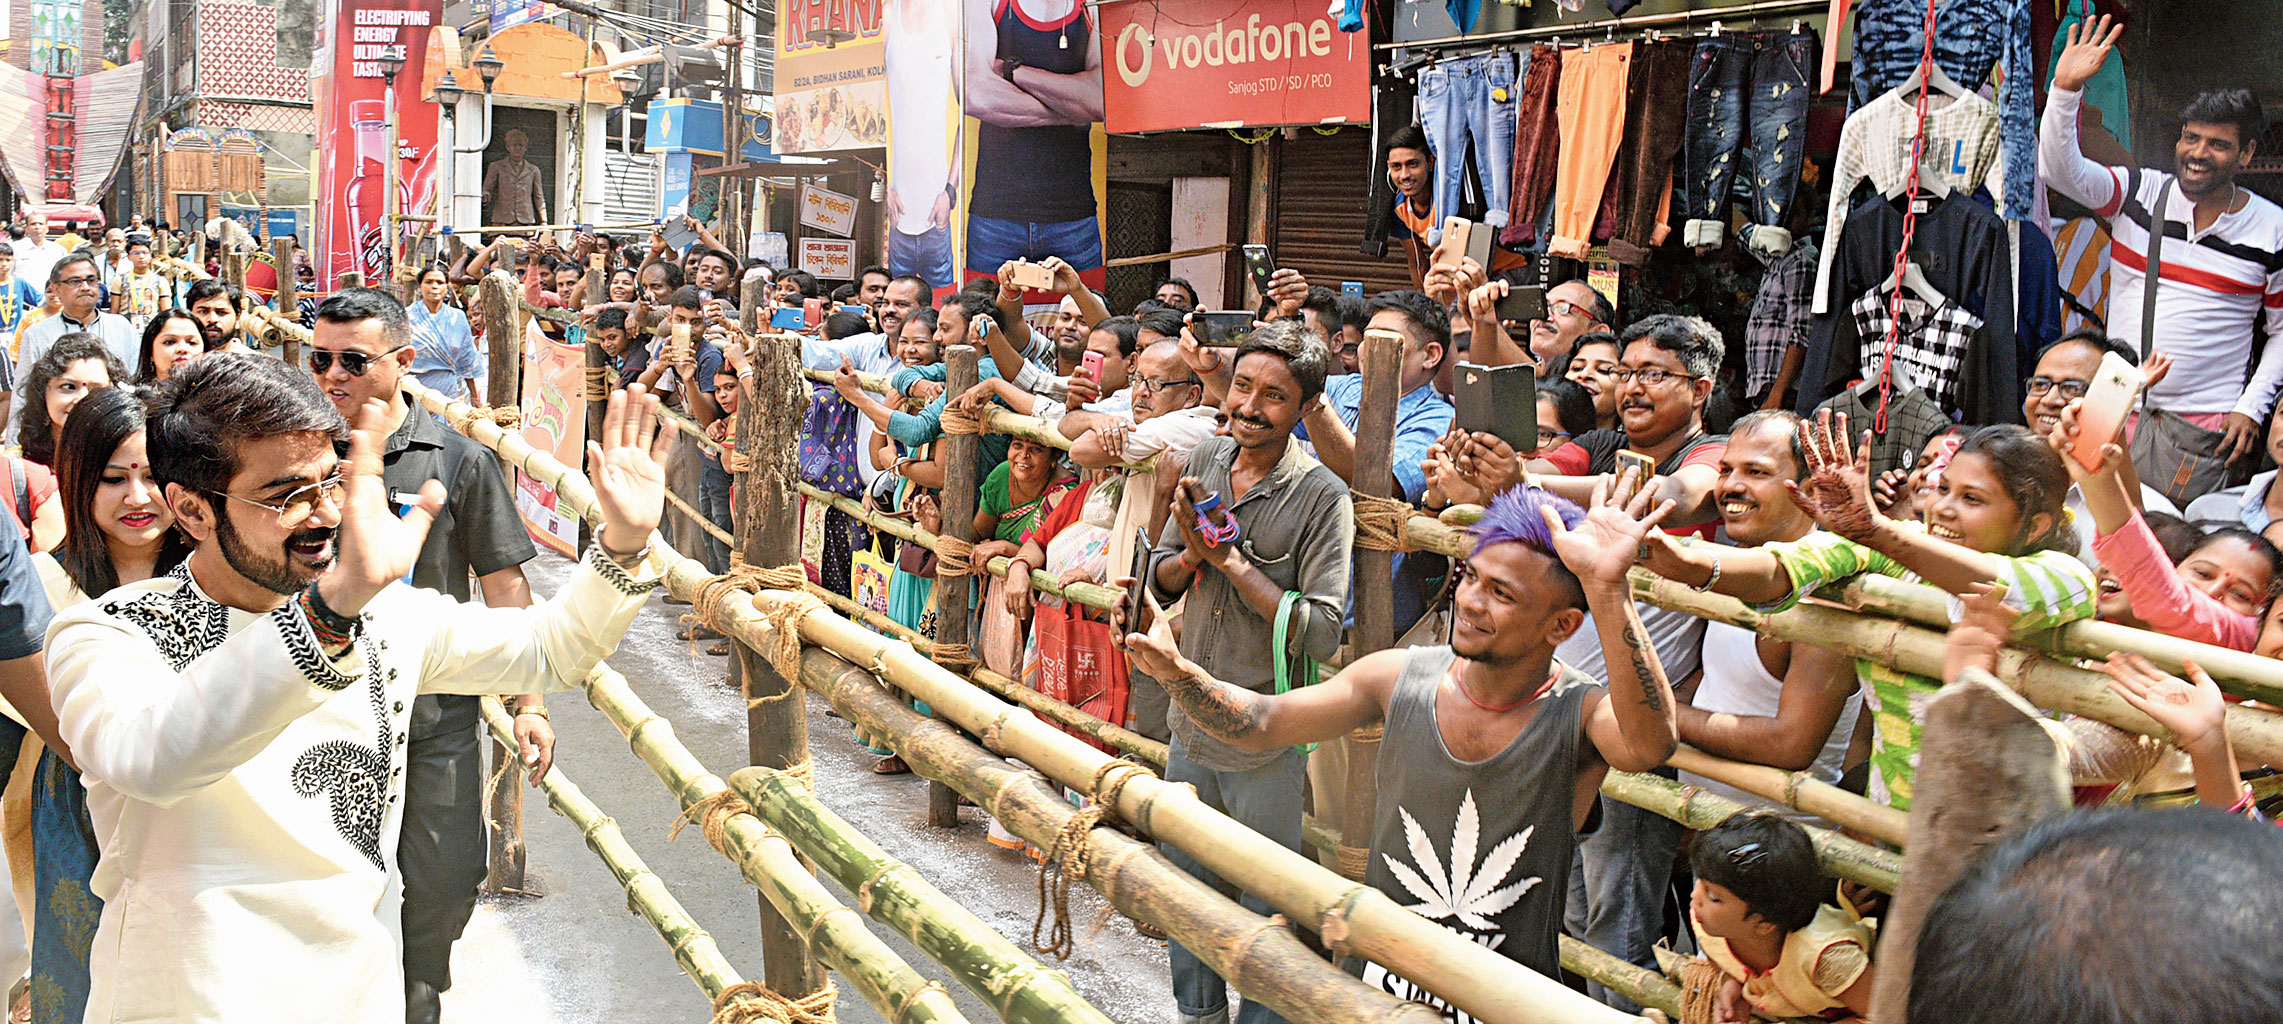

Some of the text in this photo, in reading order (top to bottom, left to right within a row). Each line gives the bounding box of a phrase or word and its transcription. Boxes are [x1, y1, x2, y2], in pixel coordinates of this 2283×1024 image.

[355, 10, 430, 26] ELECTRIFYING
[354, 27, 398, 43] ENERGY
[1162, 14, 1331, 70] vodafone
[353, 44, 407, 60] ULTIMTE
[813, 72, 837, 85] BIDHAN
[1228, 80, 1258, 96] Sanjog
[1259, 77, 1277, 92] STD
[1311, 73, 1332, 88] PCO
